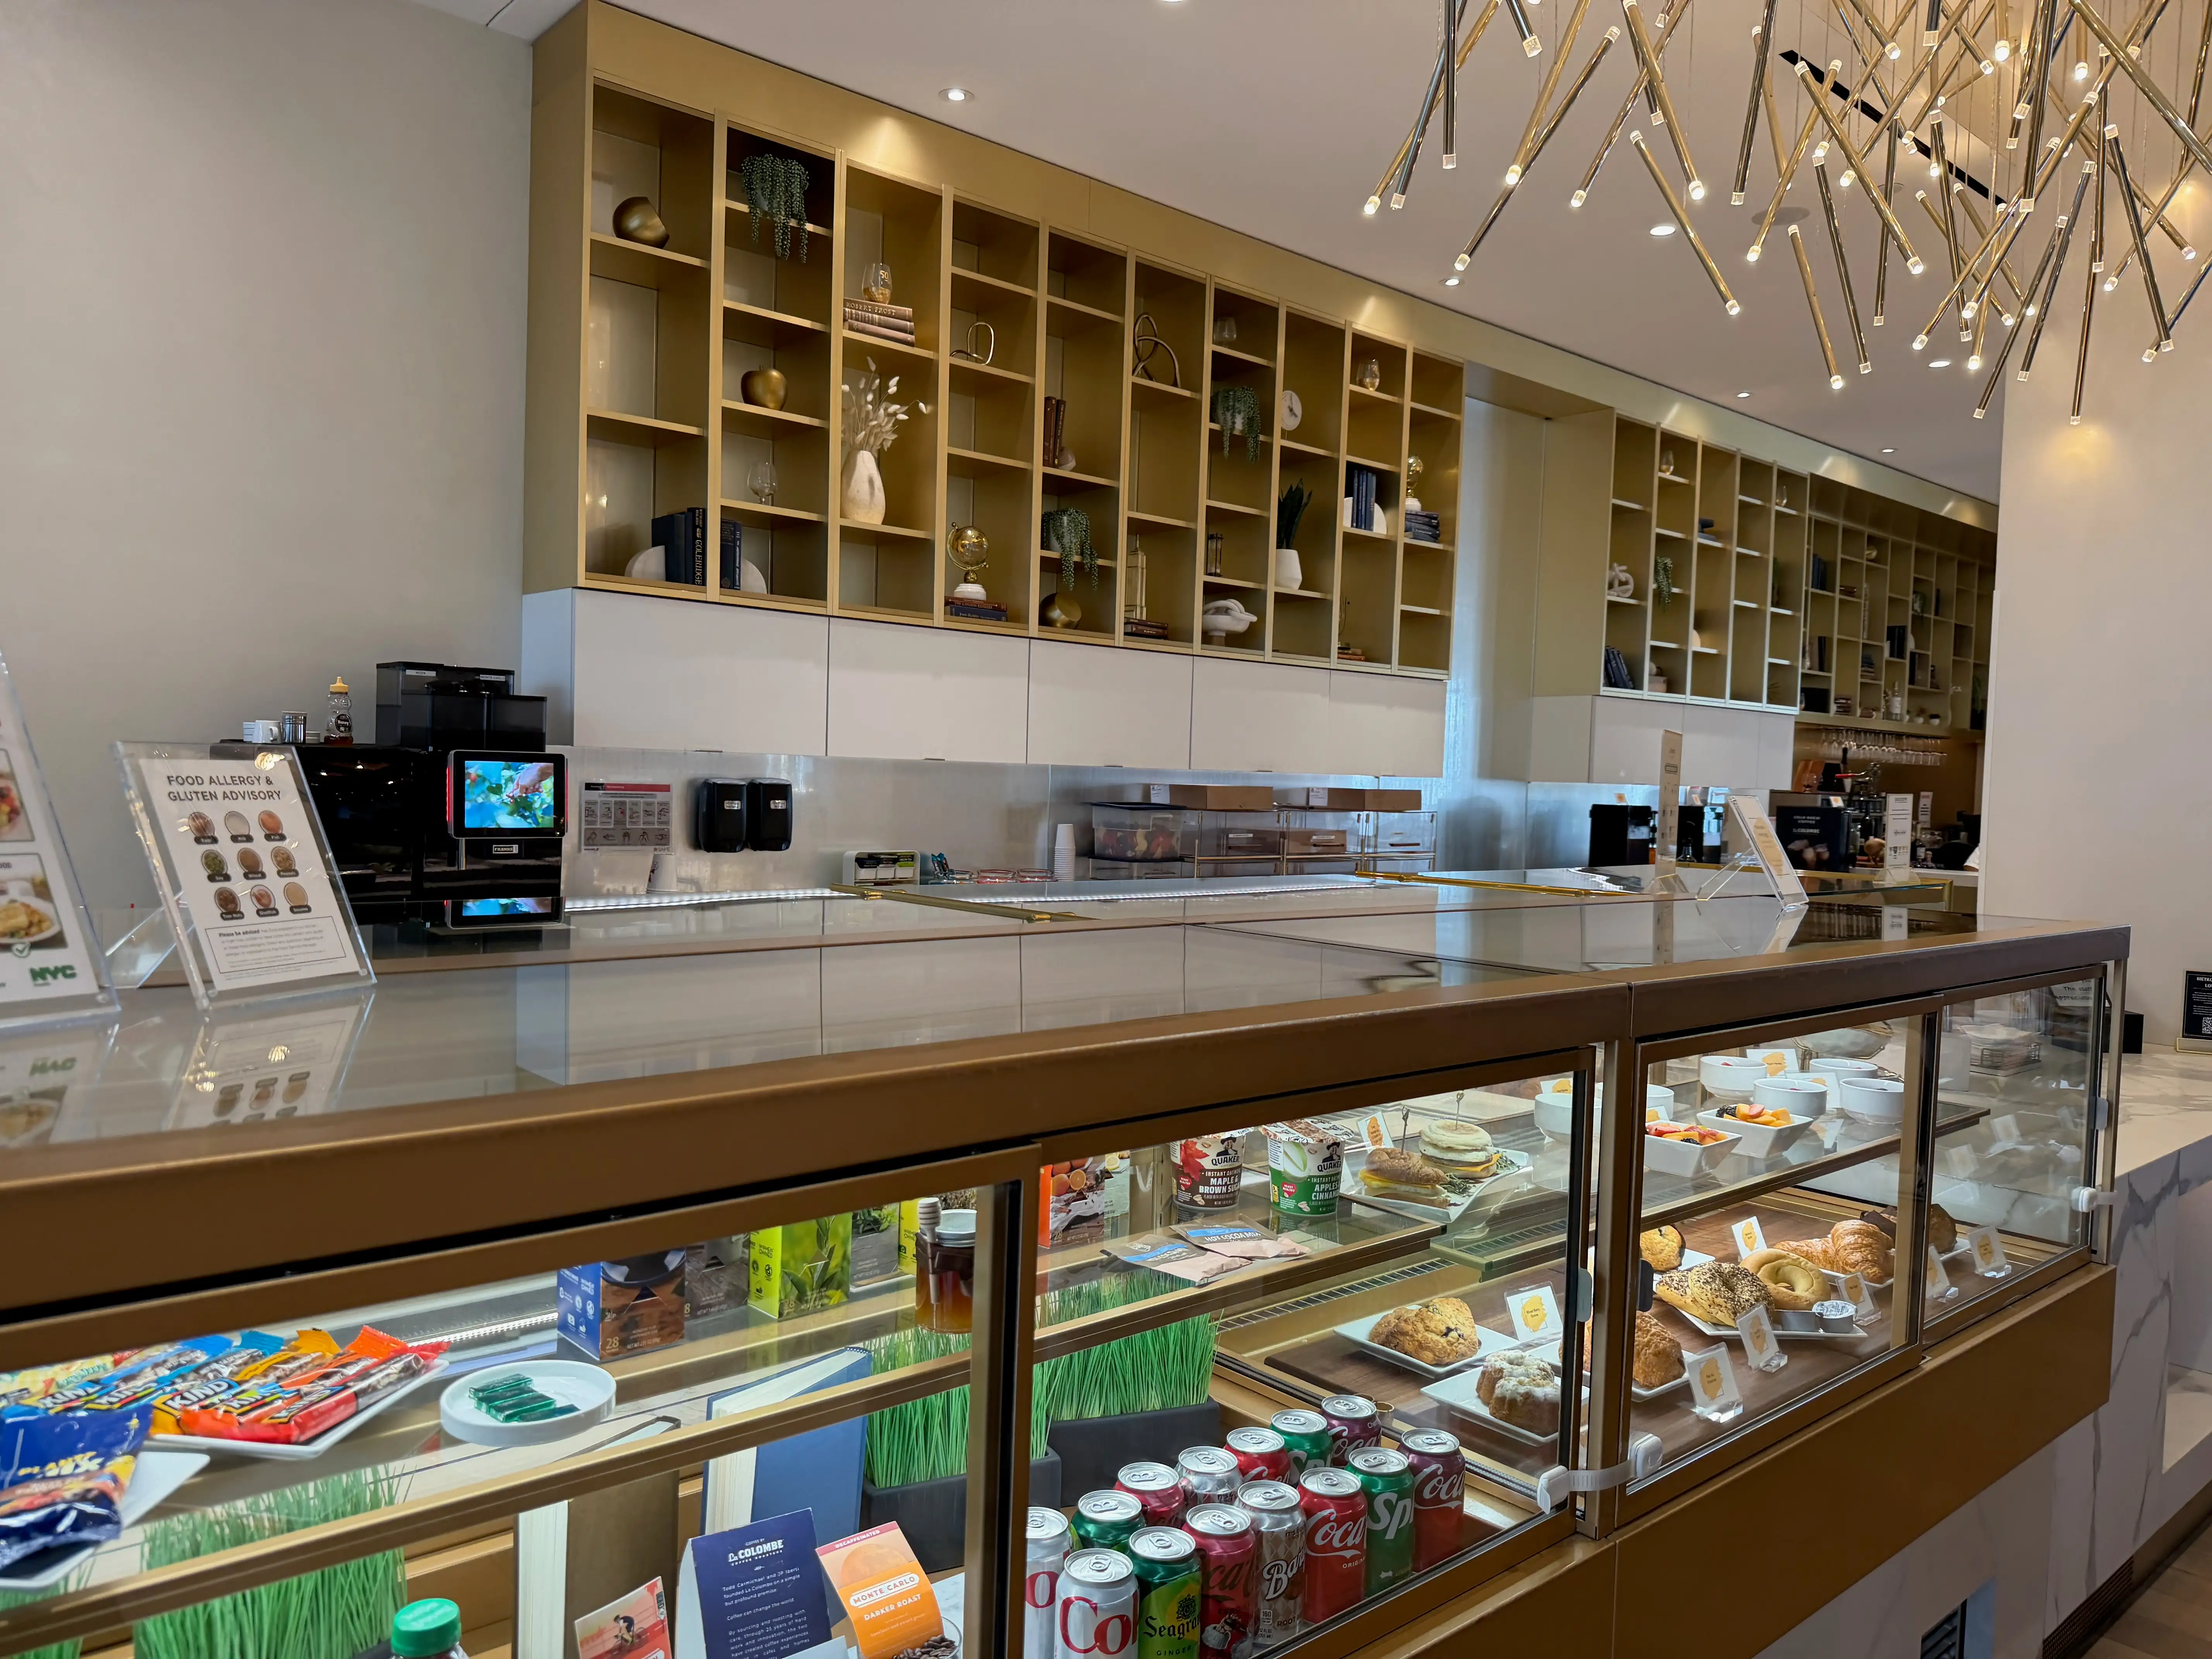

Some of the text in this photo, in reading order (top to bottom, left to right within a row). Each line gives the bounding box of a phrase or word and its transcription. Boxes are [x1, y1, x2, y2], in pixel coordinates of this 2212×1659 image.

[846, 302, 896, 315] ROBERT FROST
[167, 776, 273, 785] FOOD ALLERGY &
[168, 790, 281, 801] GLUTEN ADVISORY
[29, 964, 77, 983] NYC
[1211, 1155, 1240, 1166] QUAKER
[1210, 1176, 1234, 1185] MAPLE
[1199, 1185, 1226, 1194] BROWN
[1314, 1182, 1338, 1192] APPLES
[1222, 1233, 1247, 1241] COCOA
[684, 1302, 690, 1314] 8
[606, 1337, 619, 1350] 28
[166, 1381, 228, 1410] KIND
[1306, 1509, 1367, 1555] Coca
[835, 1530, 881, 1549] DECAFFEINATED
[728, 1539, 784, 1562] La COLOMBE
[723, 1590, 744, 1599] founded
[752, 1582, 773, 1591] Colombe
[785, 1573, 800, 1582] simple
[737, 1576, 765, 1588] Carmichael
[852, 1576, 916, 1604] MONTE CARLO
[735, 1594, 756, 1604] profound
[753, 1605, 771, 1613] change
[864, 1593, 921, 1621] DARKER ROAST
[737, 1623, 759, 1633] sourcing
[772, 1613, 793, 1622] roasting
[1277, 1616, 1296, 1627] ROOT
[744, 1629, 764, 1638] through
[774, 1623, 787, 1631] years
[745, 1645, 763, 1654] created
[781, 1631, 809, 1642] experiences
[794, 1638, 810, 1646] homes
[1156, 1645, 1192, 1656] GINGER
